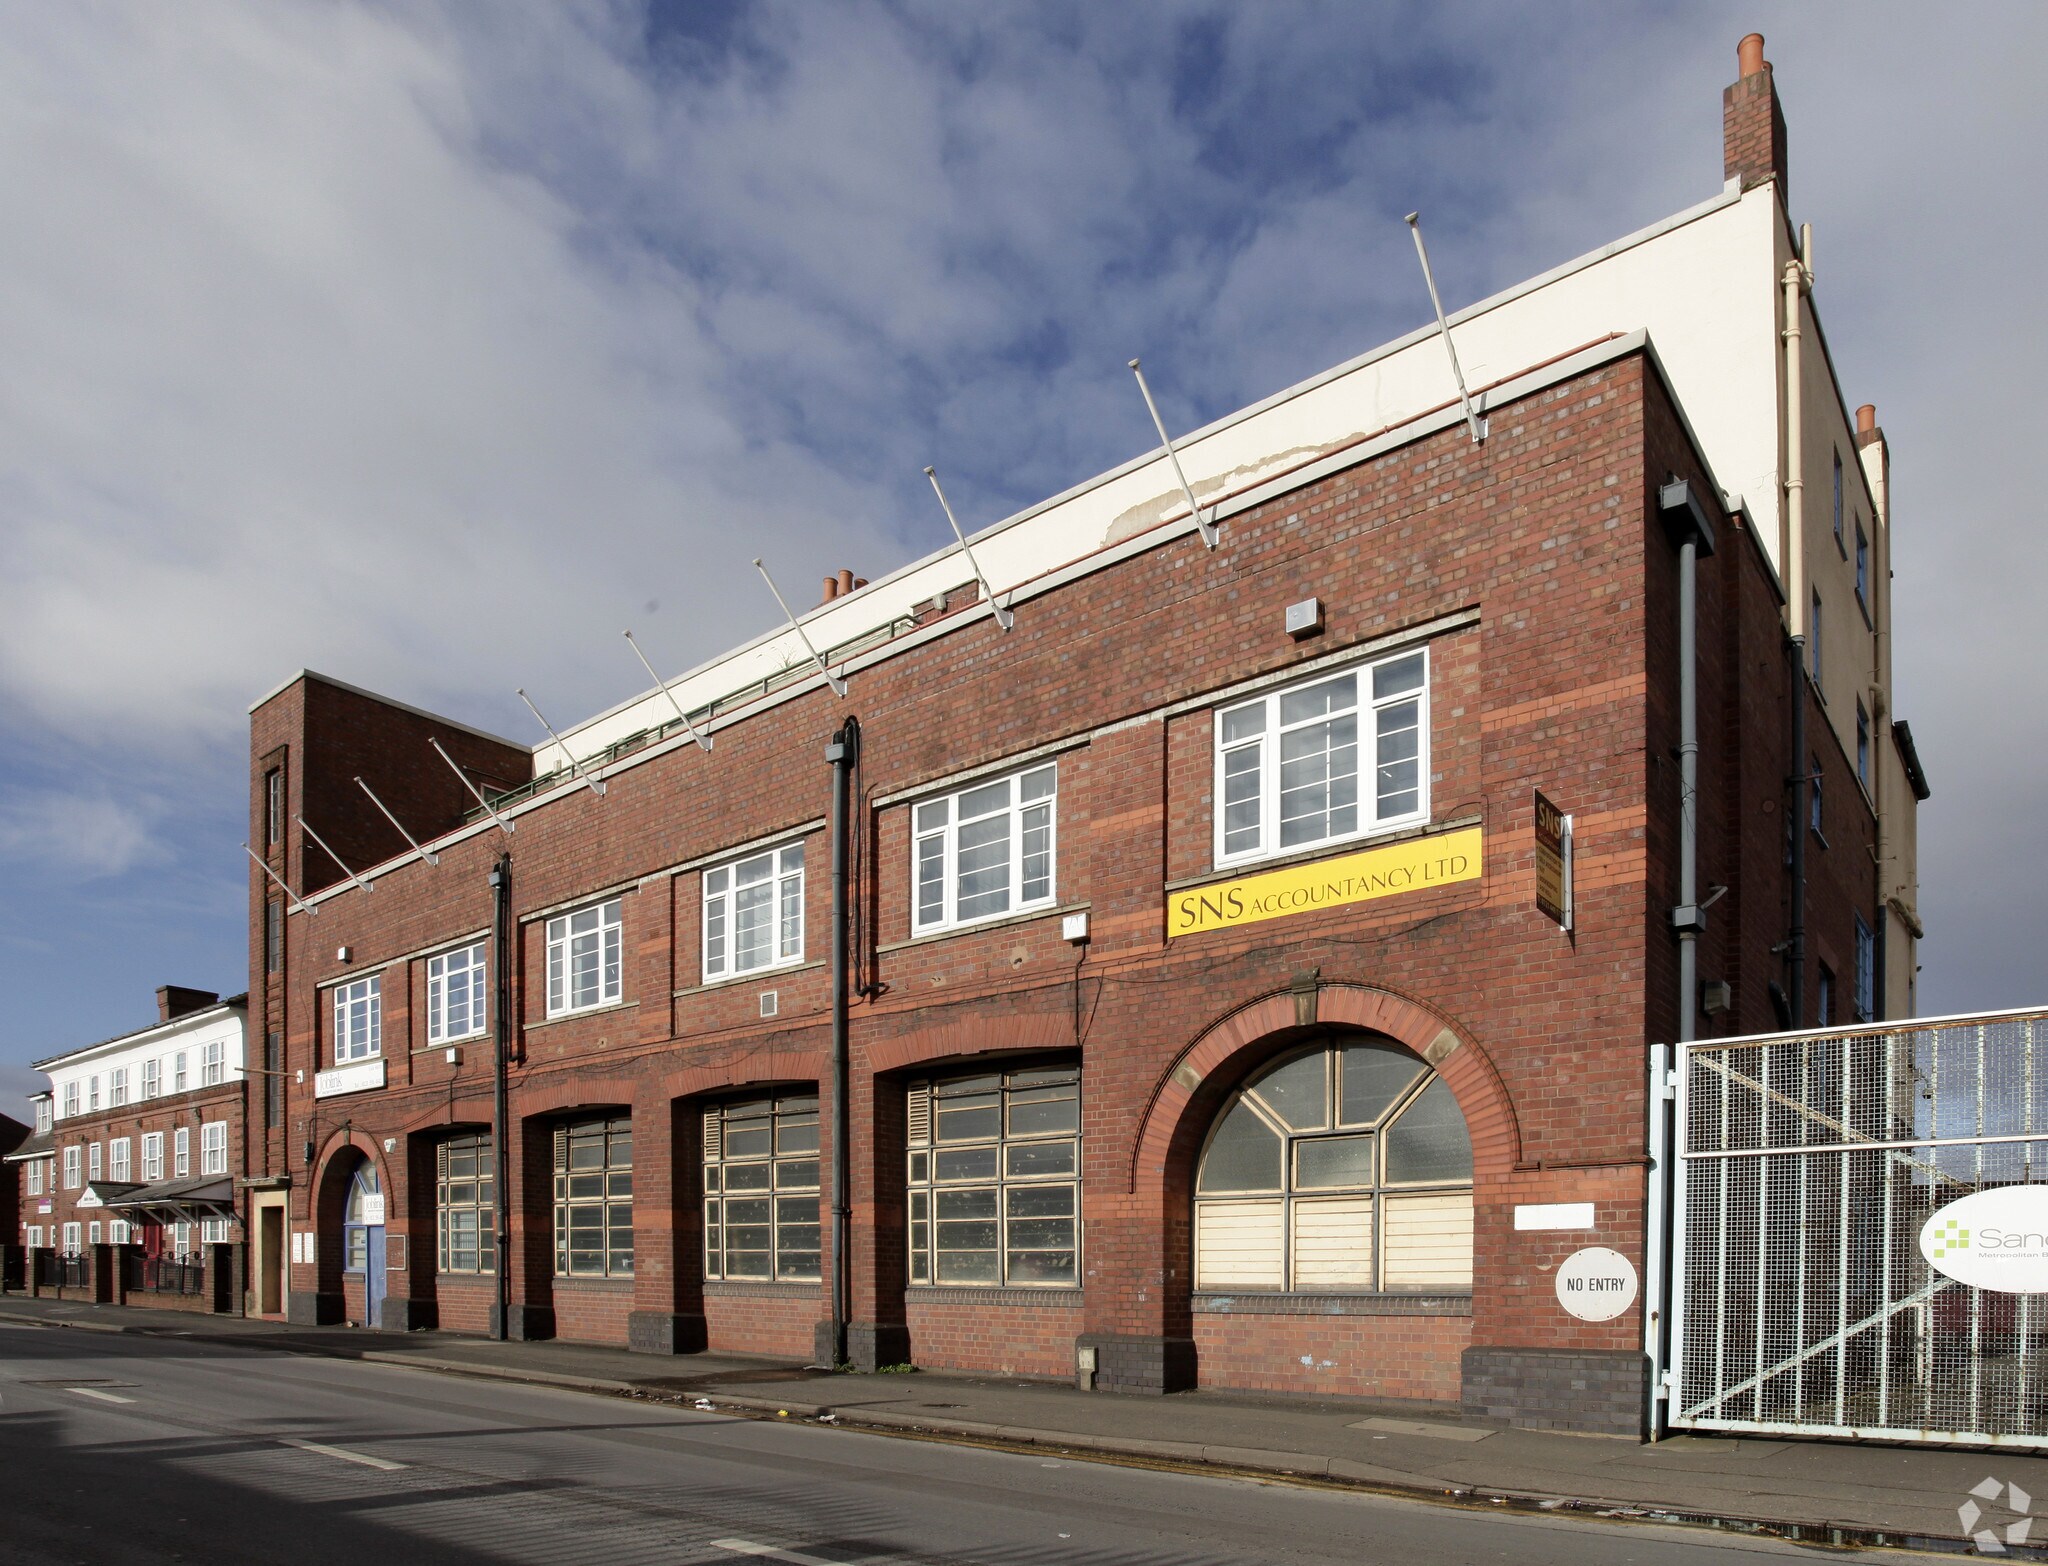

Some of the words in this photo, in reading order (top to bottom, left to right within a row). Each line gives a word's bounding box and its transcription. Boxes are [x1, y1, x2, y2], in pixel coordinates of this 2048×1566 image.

[1539, 802, 1560, 840] SNS
[1180, 887, 1244, 928] SNS
[1250, 865, 1416, 915] ACCOUNTANCY
[1424, 855, 1468, 881] LTD
[1979, 1228, 2048, 1248] San
[1567, 1278, 1583, 1291] NO
[1589, 1278, 1626, 1291] ENTRY
